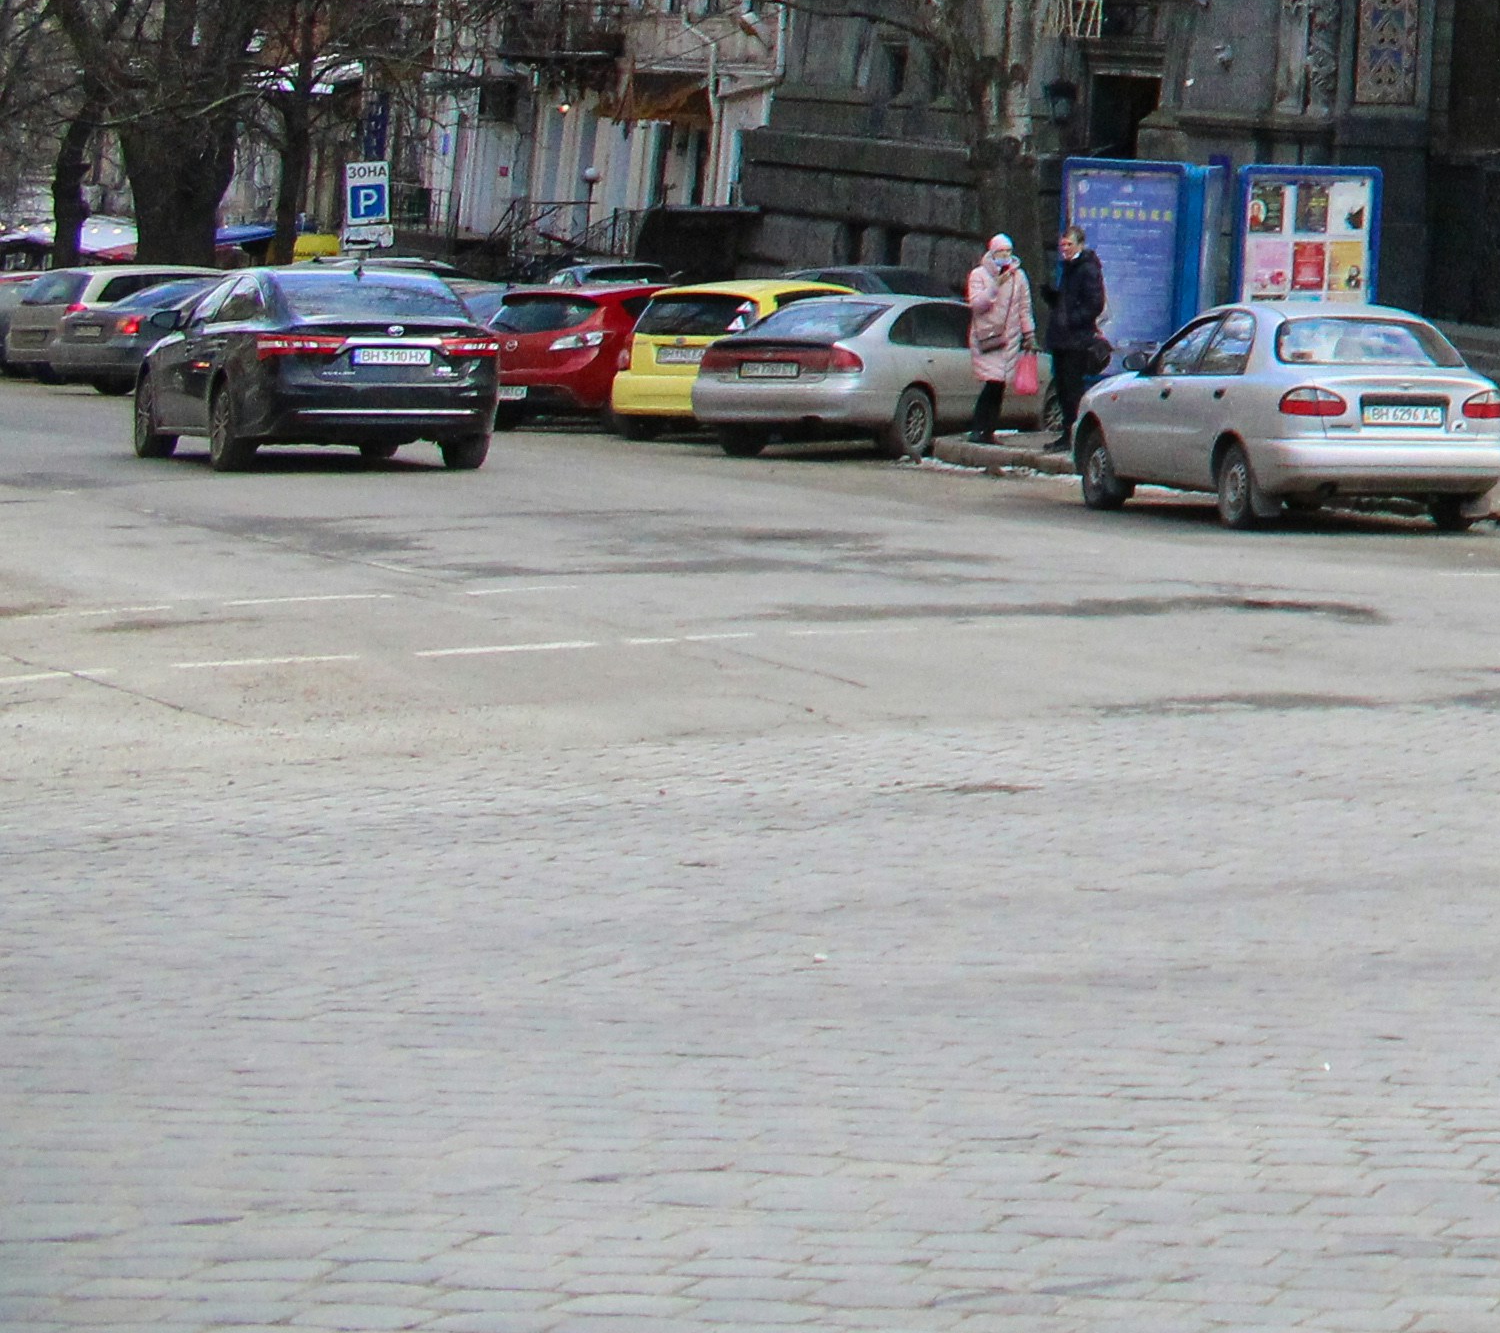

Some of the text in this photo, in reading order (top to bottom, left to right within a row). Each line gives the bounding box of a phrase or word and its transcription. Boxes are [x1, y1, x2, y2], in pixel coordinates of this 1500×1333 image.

[348, 165, 388, 179] ЗОНА
[359, 188, 378, 215] P
[361, 350, 427, 363] BH 3110 HX
[1371, 407, 1390, 421] BH
[1422, 407, 1440, 422] AC
